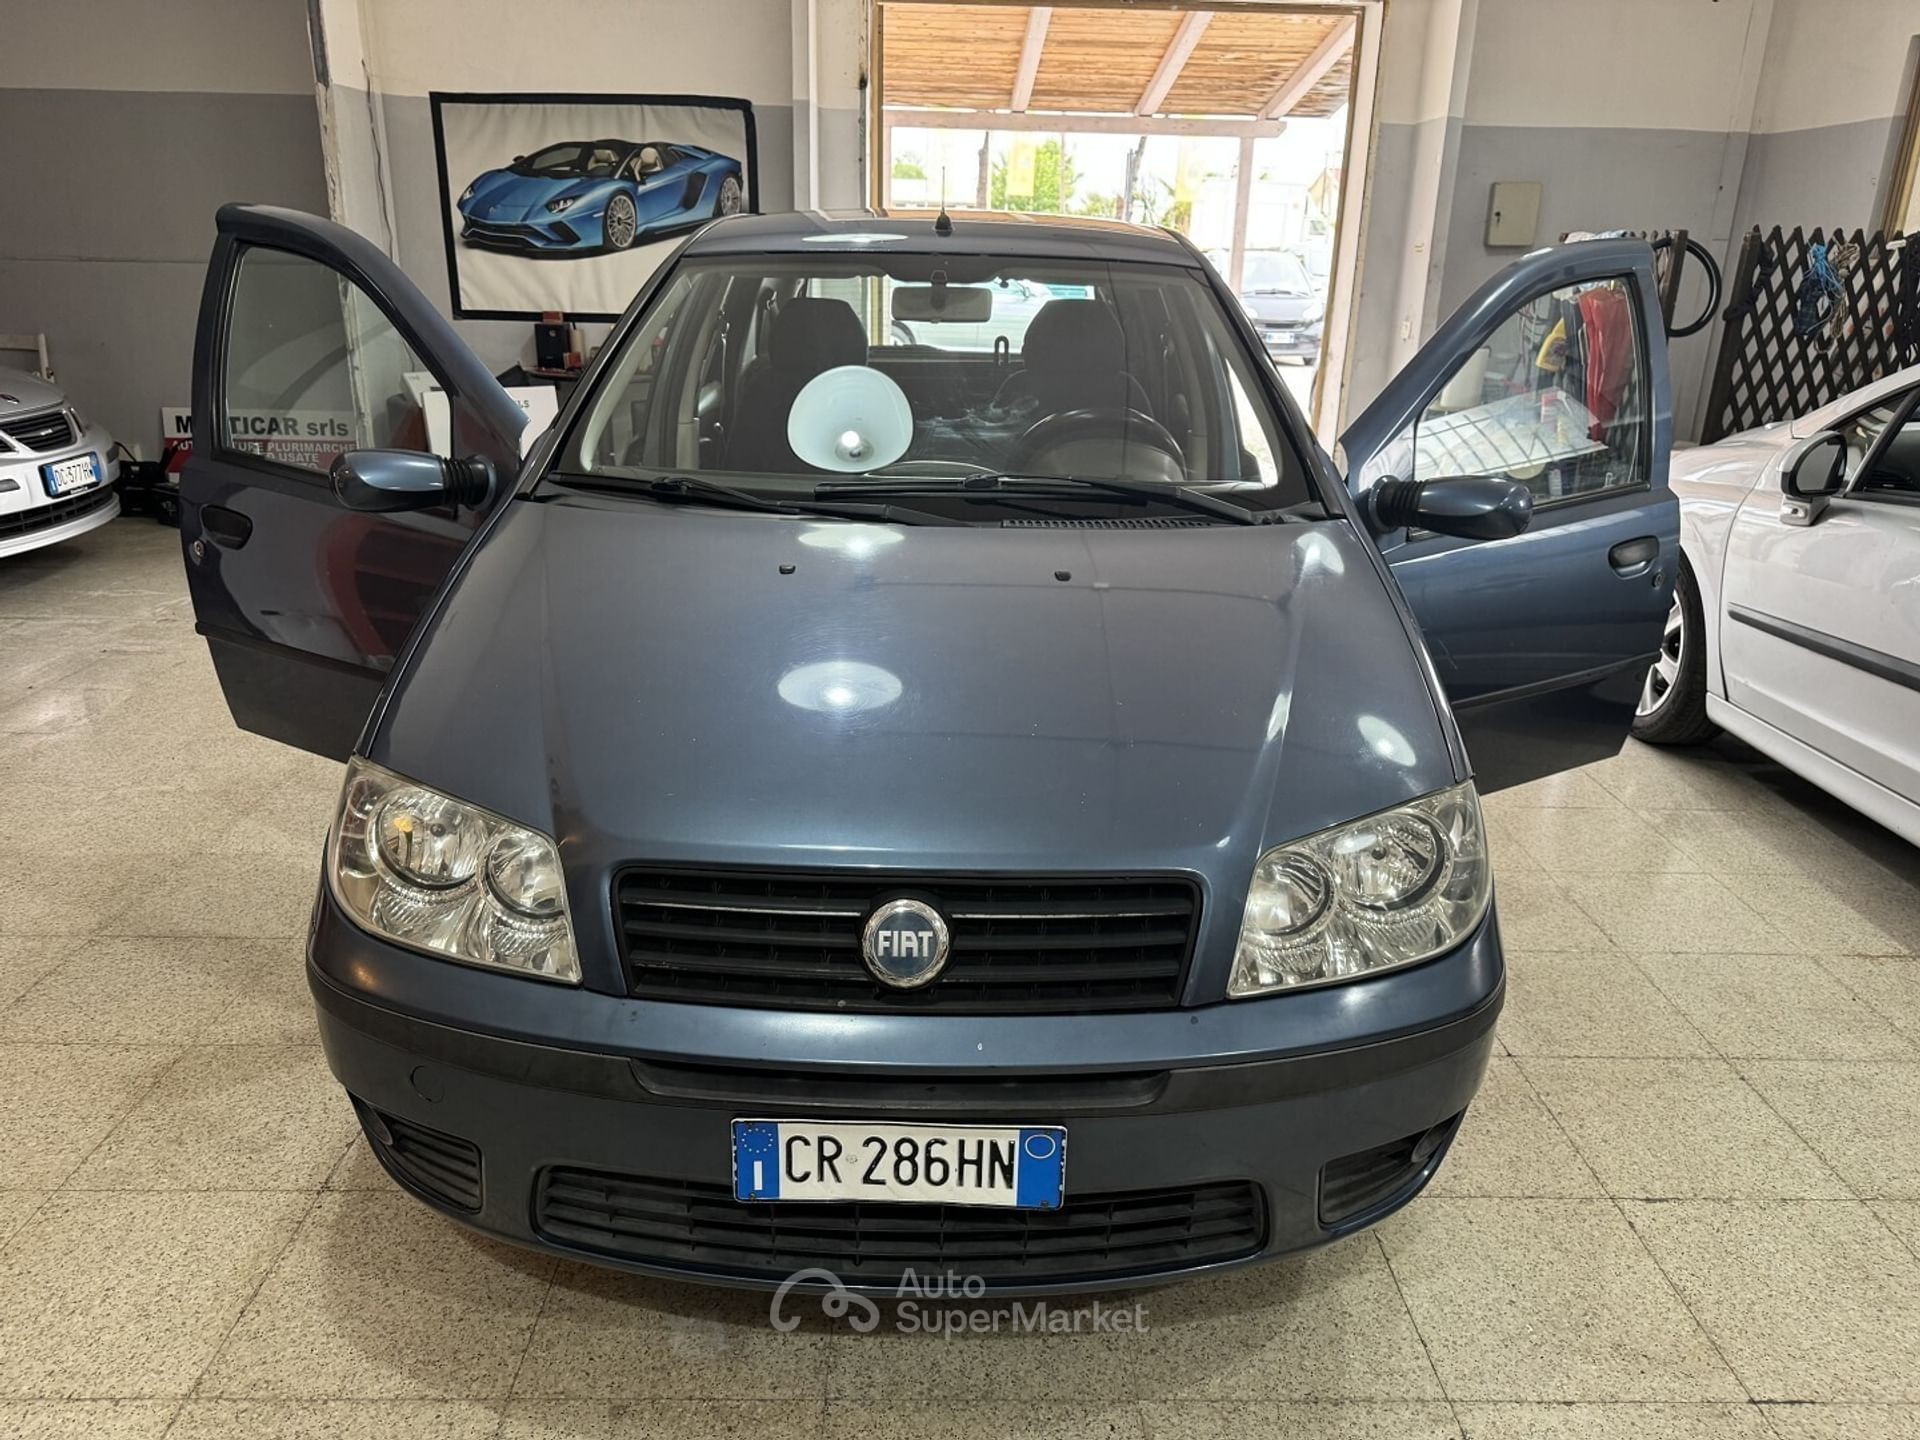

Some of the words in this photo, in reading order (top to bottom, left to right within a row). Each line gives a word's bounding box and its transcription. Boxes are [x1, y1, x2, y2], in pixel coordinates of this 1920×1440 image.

[175, 414, 299, 436] MTICAR
[306, 418, 349, 437] srls
[278, 452, 320, 463] USATE
[877, 930, 934, 957] FIAT
[785, 1135, 843, 1183] CR
[861, 1136, 1016, 1190] 286HN
